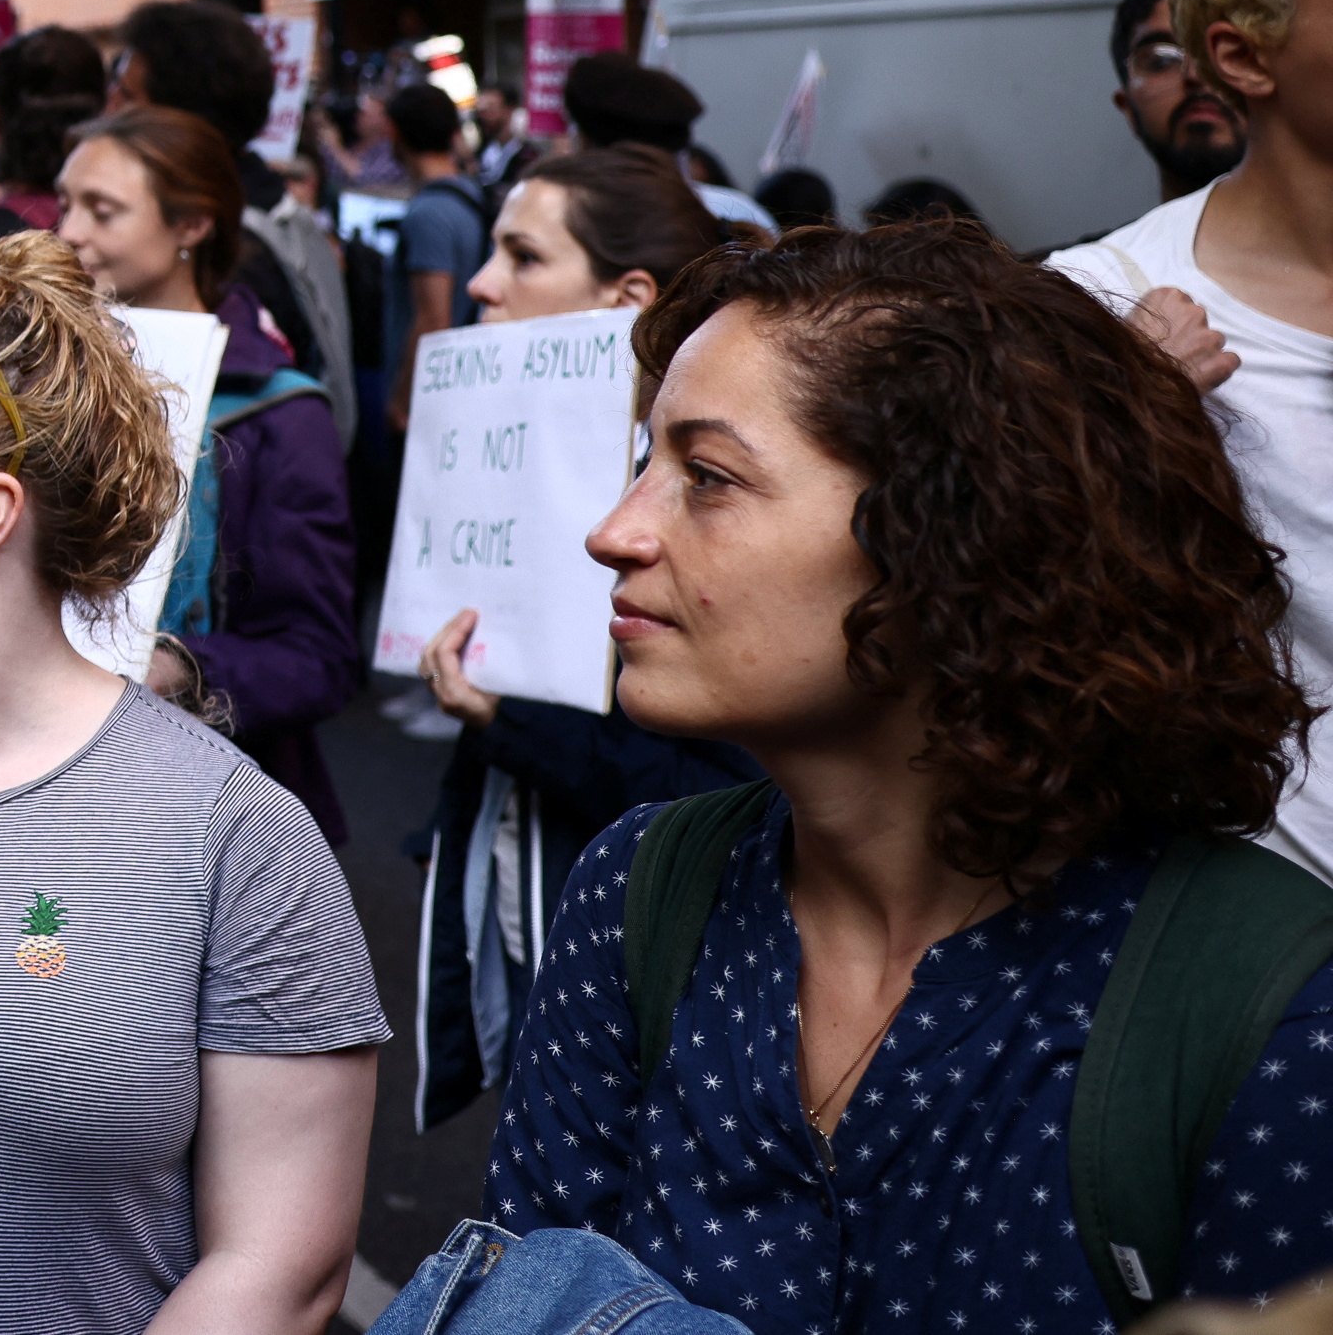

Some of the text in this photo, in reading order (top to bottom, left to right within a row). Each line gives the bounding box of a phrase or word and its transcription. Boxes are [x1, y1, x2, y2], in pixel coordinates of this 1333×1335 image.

[422, 332, 616, 393] SEEKING ASYLUM
[439, 422, 527, 472] IS NOT
[417, 518, 516, 568] A CRIME
